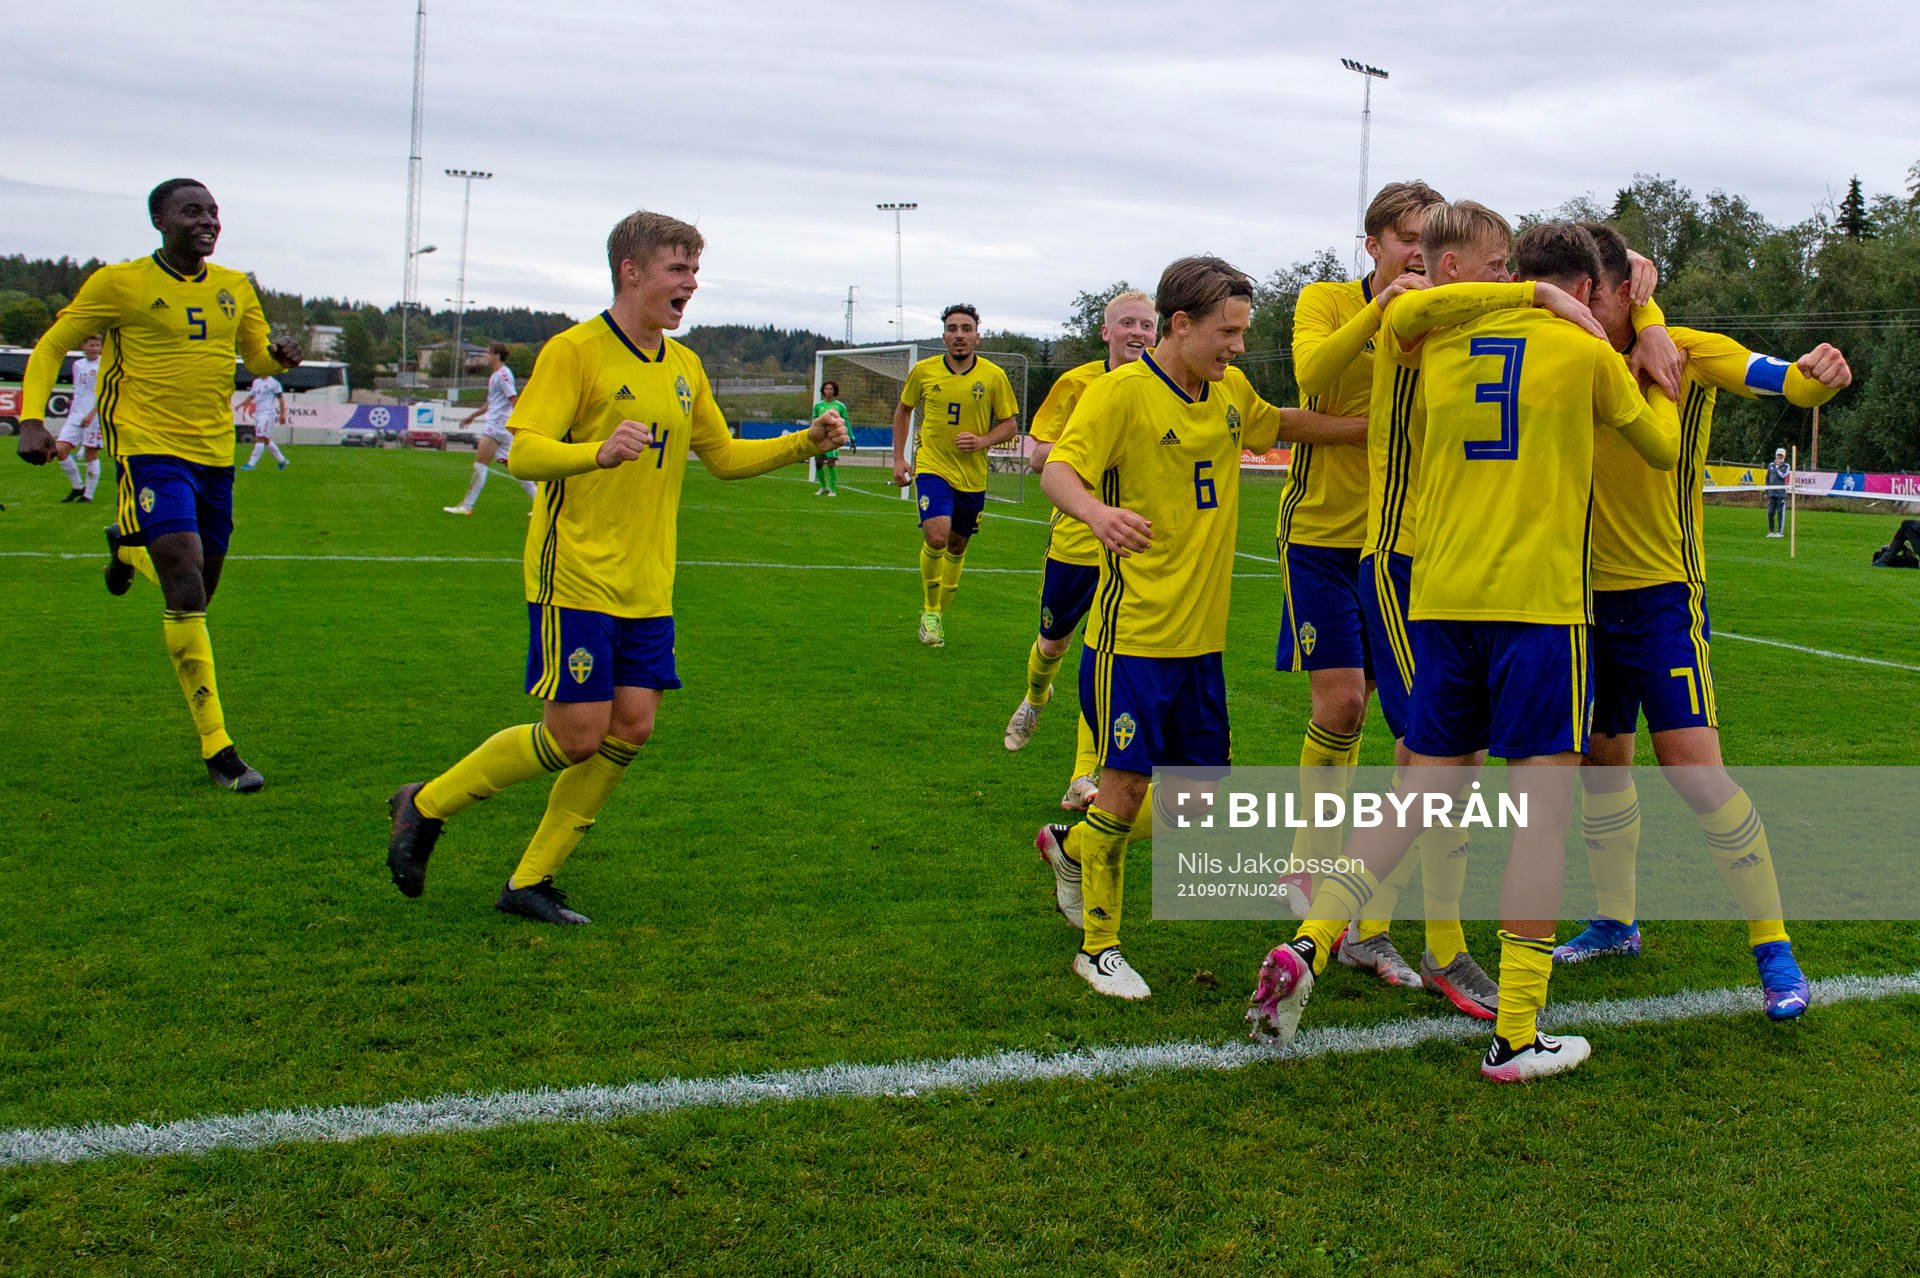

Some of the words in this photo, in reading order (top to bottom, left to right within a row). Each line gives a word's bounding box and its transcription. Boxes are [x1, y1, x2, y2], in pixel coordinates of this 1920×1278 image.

[187, 307, 206, 340] 5
[947, 402, 961, 425] 9
[1464, 337, 1527, 461] 3
[648, 422, 669, 469] 4
[1193, 460, 1218, 510] 6
[1670, 666, 1700, 716] 7
